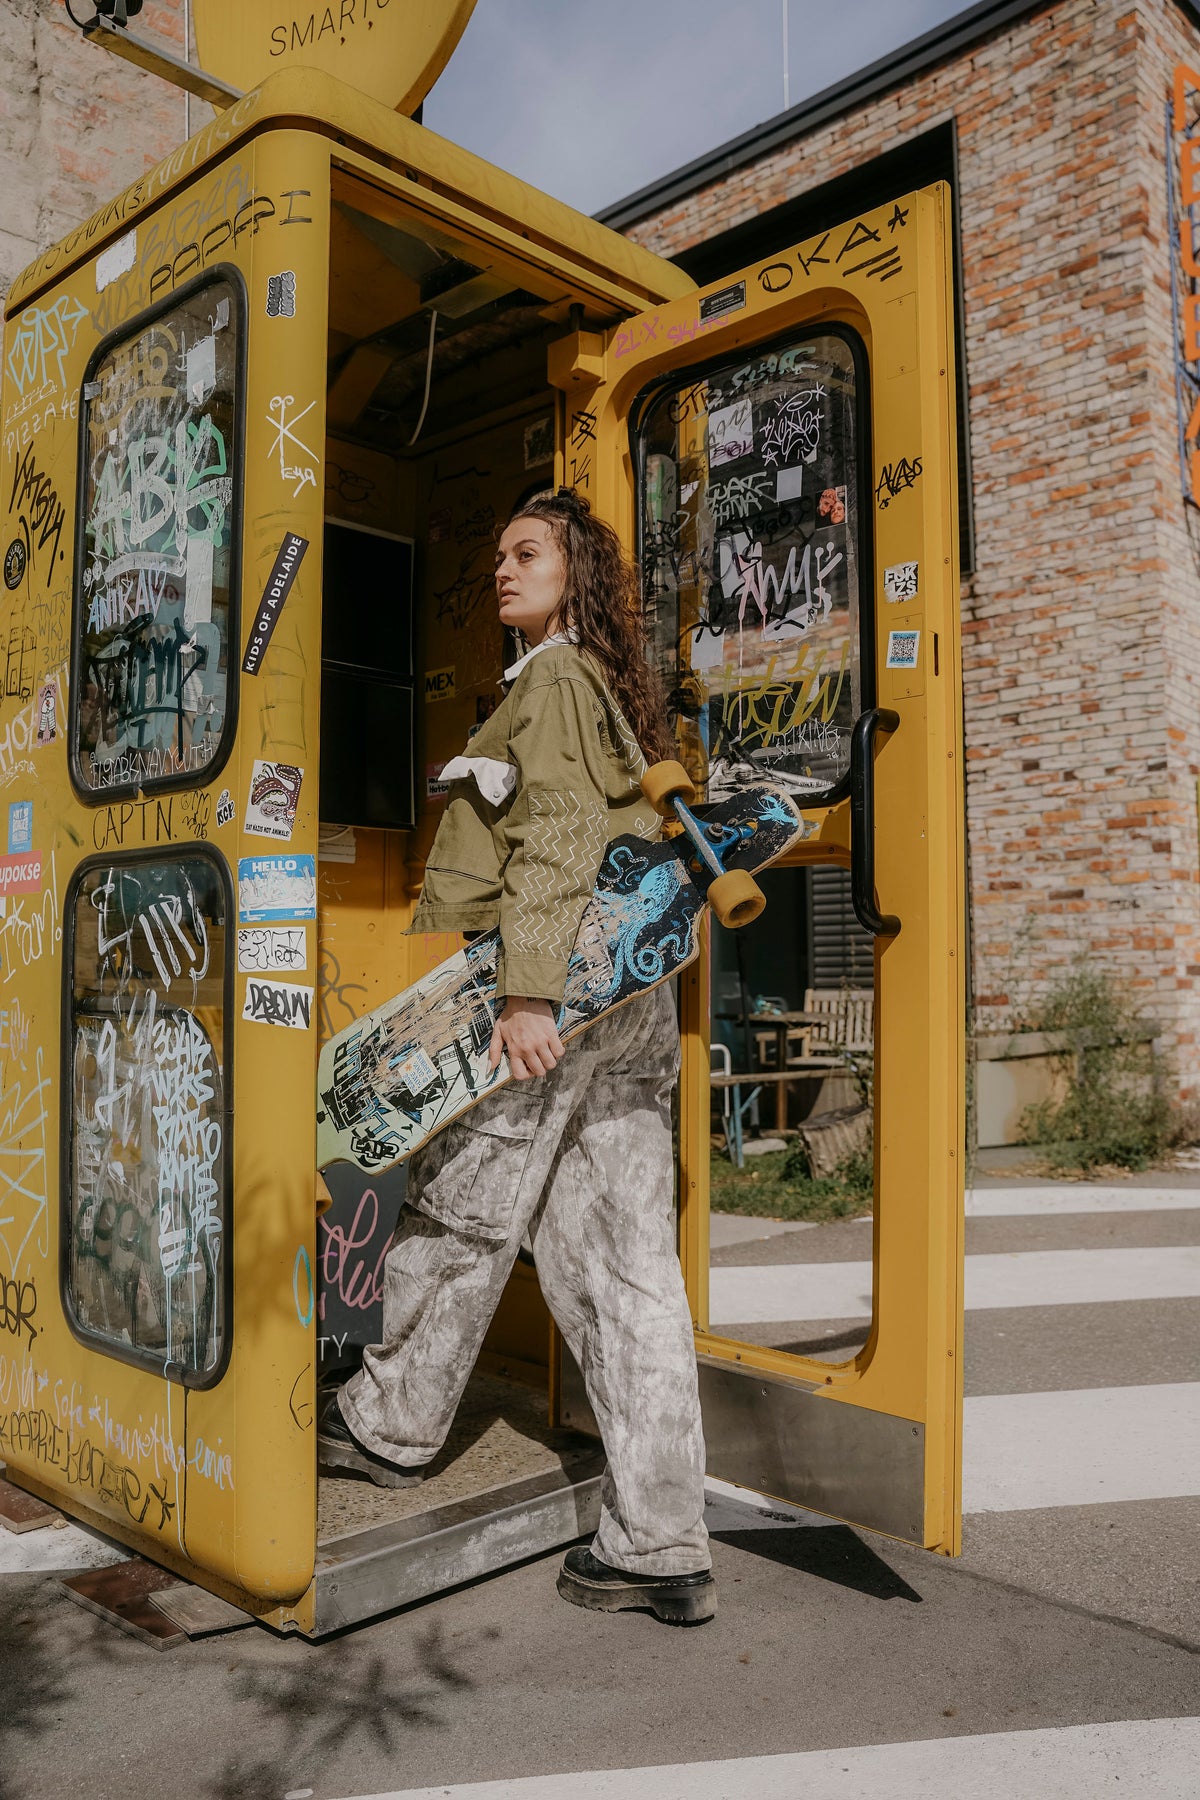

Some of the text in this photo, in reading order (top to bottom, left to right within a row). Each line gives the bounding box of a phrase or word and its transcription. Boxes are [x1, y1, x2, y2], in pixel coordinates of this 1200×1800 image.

[246, 536, 303, 672] KIDS OF ADELAIDE
[425, 671, 455, 693] MEX
[252, 859, 297, 872] HELLO
